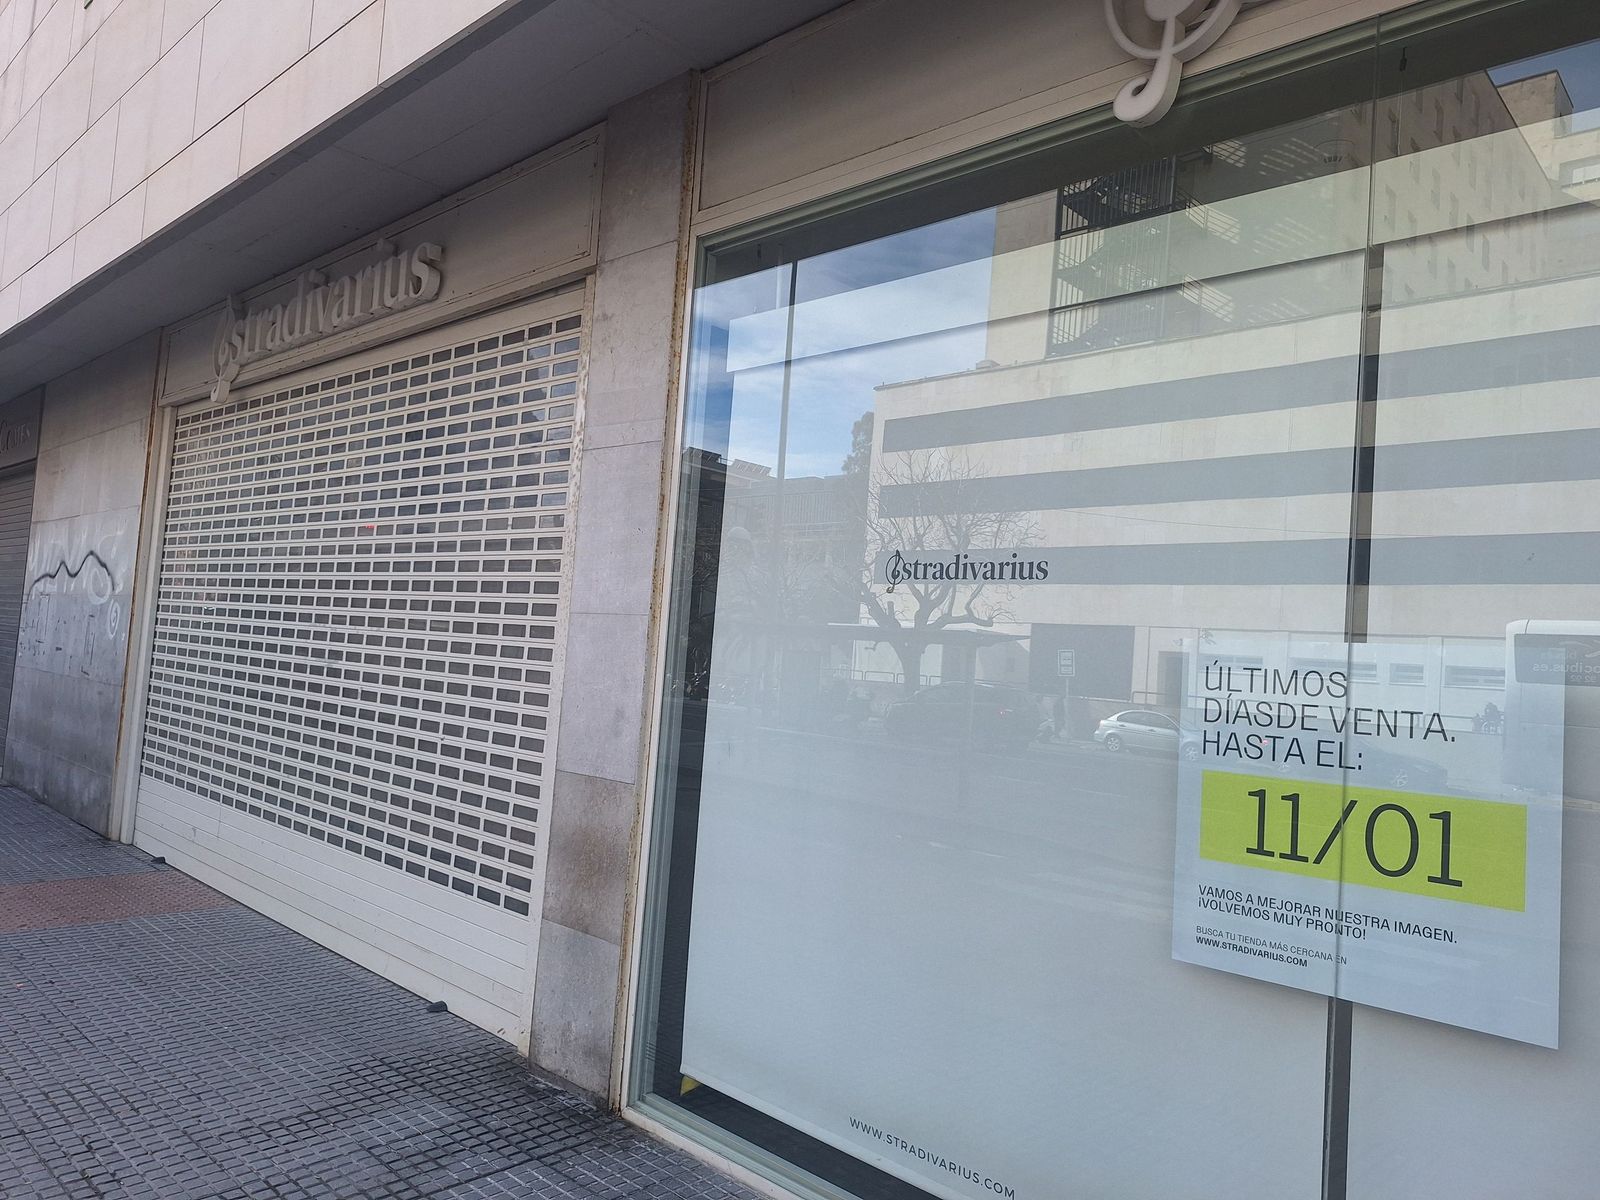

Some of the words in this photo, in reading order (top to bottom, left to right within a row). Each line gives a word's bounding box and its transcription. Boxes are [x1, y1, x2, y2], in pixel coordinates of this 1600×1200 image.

[228, 240, 443, 366] stradivarius
[901, 552, 1049, 582] stradivarius
[1204, 659, 1347, 699] ÚLTIMOS
[1328, 705, 1456, 743] VENTA.
[1202, 729, 1306, 765] HASTA
[1316, 739, 1363, 771] EL:
[1245, 788, 1464, 888] 11/01
[1198, 884, 1243, 903] VAMOS
[1245, 893, 1255, 905] A
[1257, 895, 1322, 918] MEJORAR
[1325, 907, 1391, 932] NUESTRA
[1394, 920, 1458, 944] IMAGEN.
[1273, 911, 1304, 928] MUY
[1306, 917, 1367, 941] PRONTO!
[1195, 935, 1308, 967] WWW.STRADIVARIUS.COM
[1196, 925, 1224, 938] BUSCA
[1225, 931, 1236, 941] TU
[1238, 934, 1268, 948] TIENDA
[1269, 940, 1289, 952] MÁS
[1290, 945, 1334, 961] CERCANA
[1336, 954, 1348, 965] EN
[849, 1116, 1016, 1200] WWW.STRADIVARIUS.COM
